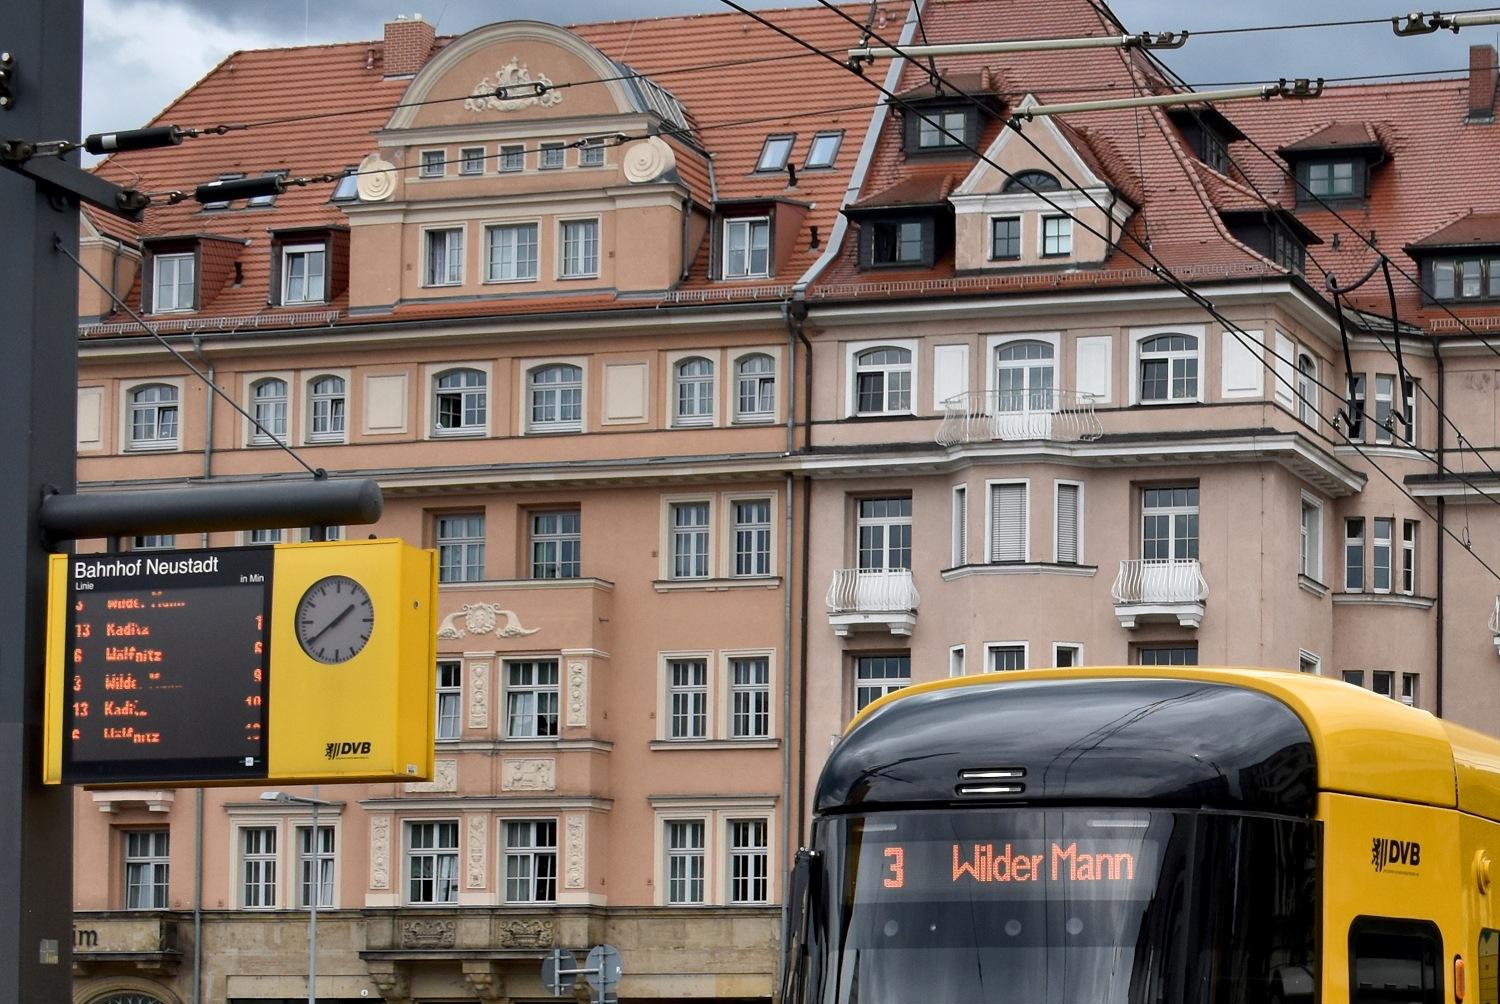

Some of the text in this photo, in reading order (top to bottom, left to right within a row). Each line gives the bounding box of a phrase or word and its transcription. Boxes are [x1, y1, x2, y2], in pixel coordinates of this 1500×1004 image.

[74, 555, 219, 579] Bahnhof Neustadt
[75, 582, 94, 591] Linie
[239, 574, 265, 584] in Min
[72, 702, 89, 717] 13
[341, 742, 372, 754] DVB
[1388, 839, 1421, 866] DVB
[883, 842, 1134, 888] 3 Wilder Mann
